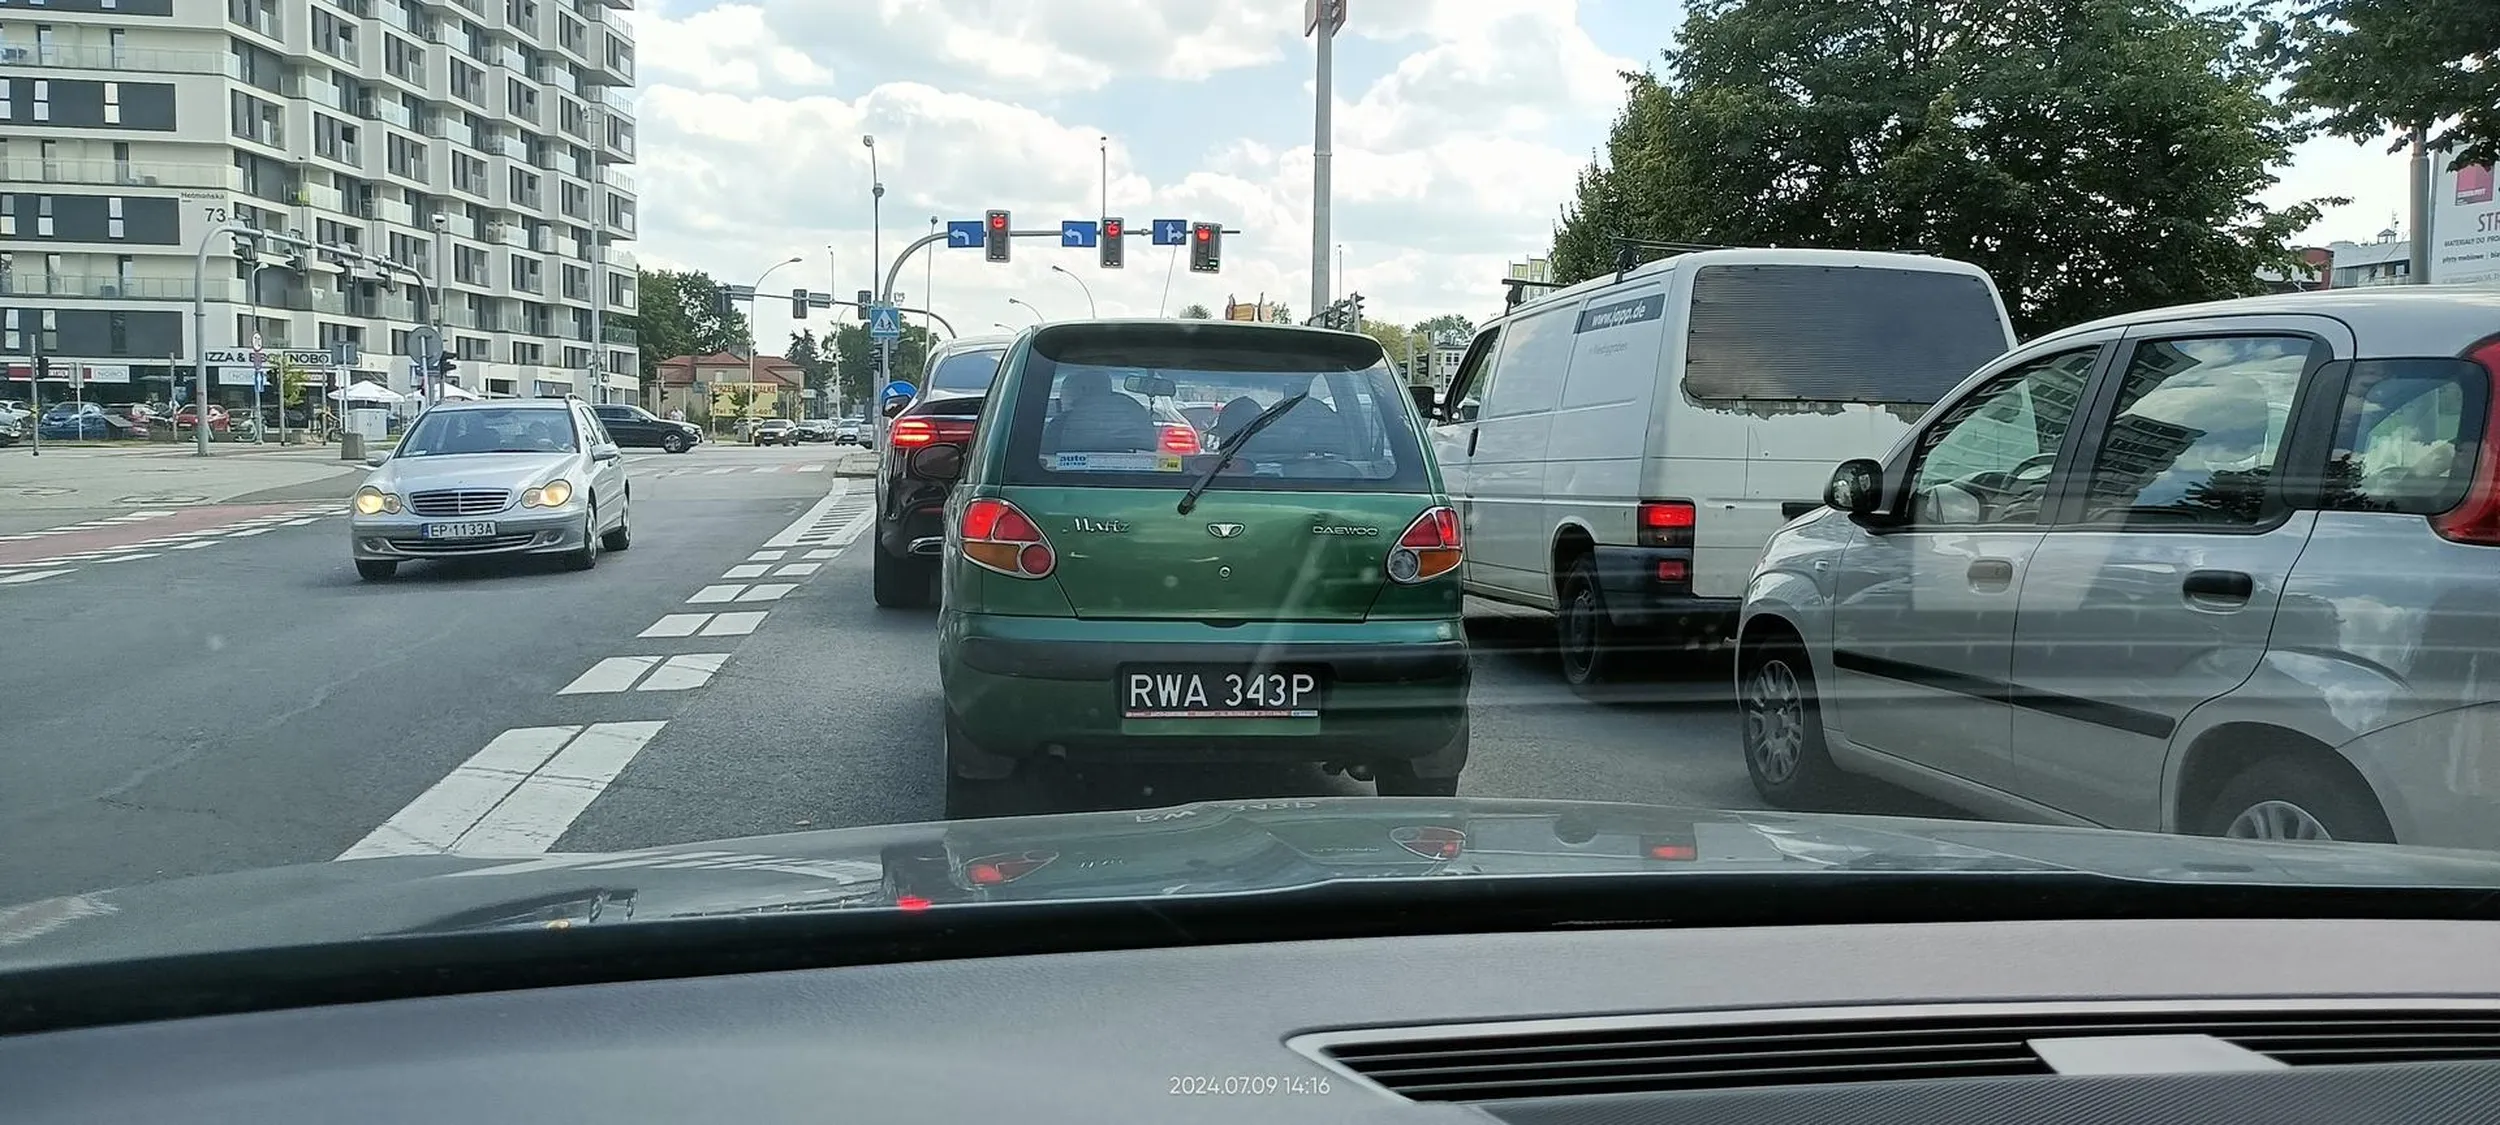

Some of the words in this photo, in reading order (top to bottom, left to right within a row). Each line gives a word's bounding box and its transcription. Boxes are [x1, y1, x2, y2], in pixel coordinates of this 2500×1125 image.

[205, 208, 226, 222] 73
[205, 352, 235, 362] IZZA
[289, 354, 329, 364] NOBO
[431, 524, 449, 537] EP
[454, 522, 494, 536] 1133A
[1312, 524, 1379, 536] DAEWOO
[1130, 673, 1209, 708] RWA
[1225, 673, 1315, 708] 343P
